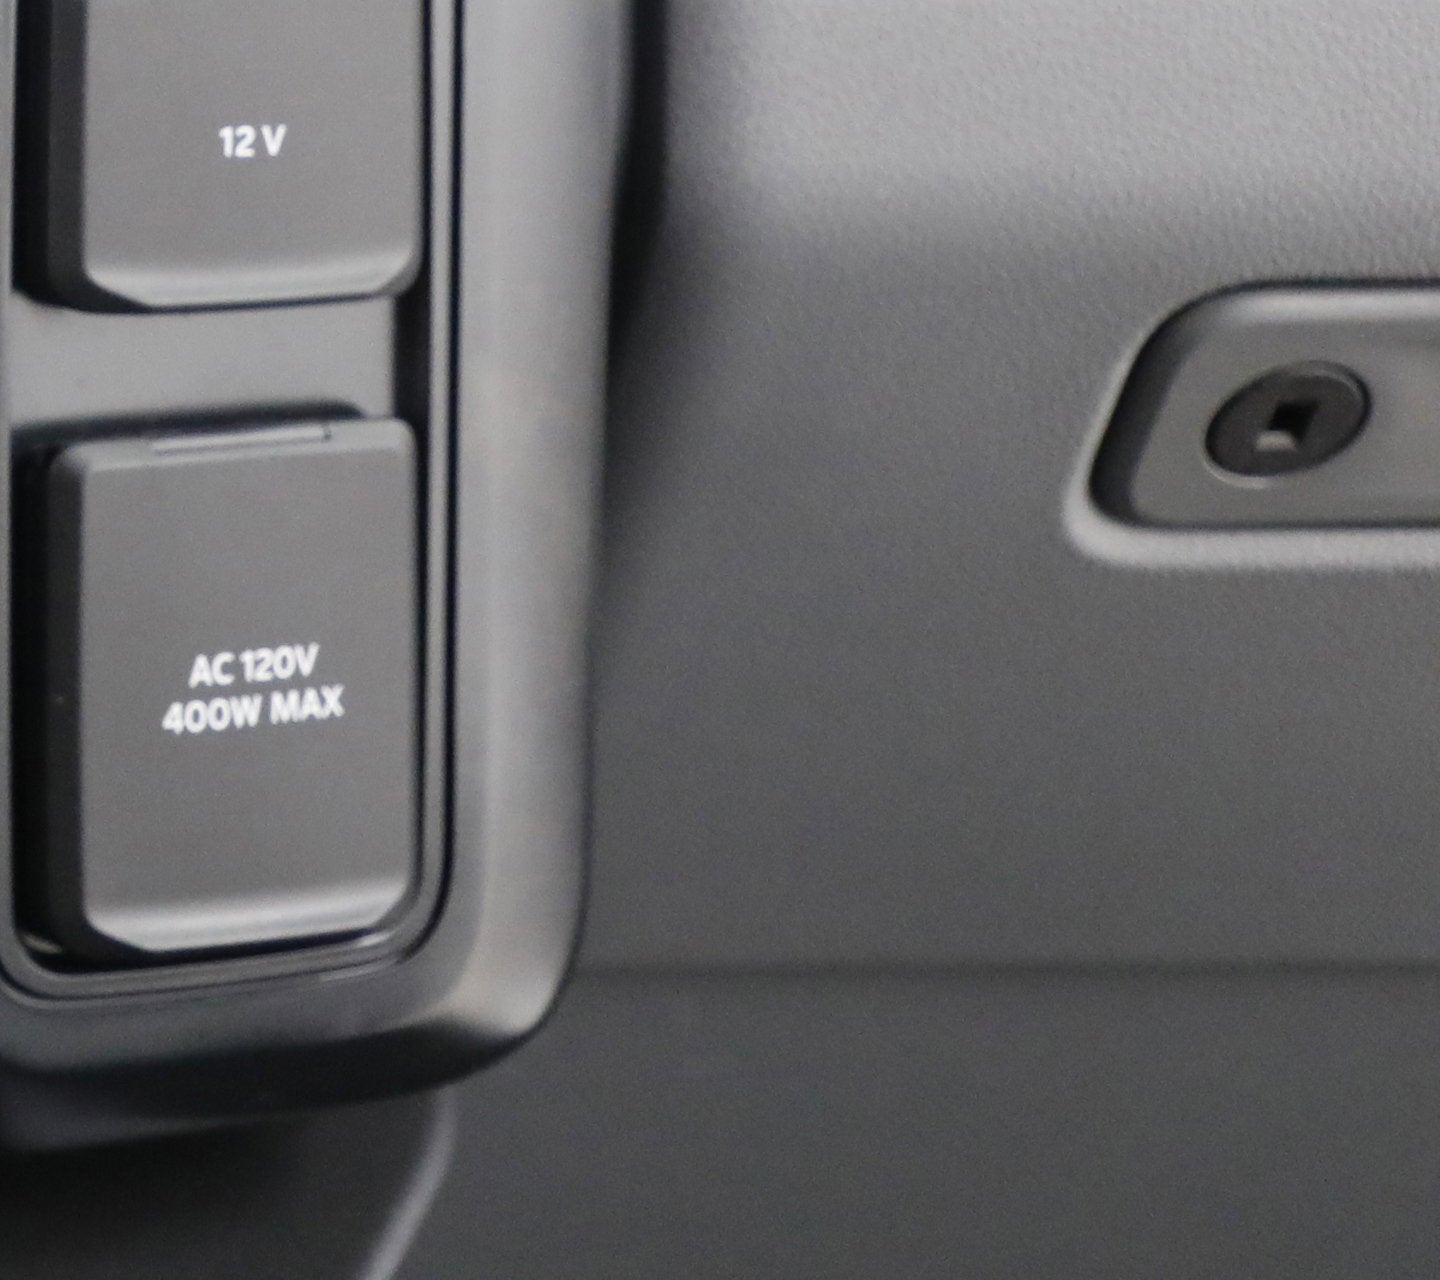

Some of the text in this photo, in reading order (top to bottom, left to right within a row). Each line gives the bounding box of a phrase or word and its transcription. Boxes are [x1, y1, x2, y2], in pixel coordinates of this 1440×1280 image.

[219, 124, 287, 159] 12 V
[189, 643, 319, 689] AC 120V
[162, 685, 344, 734] 400W MAX
